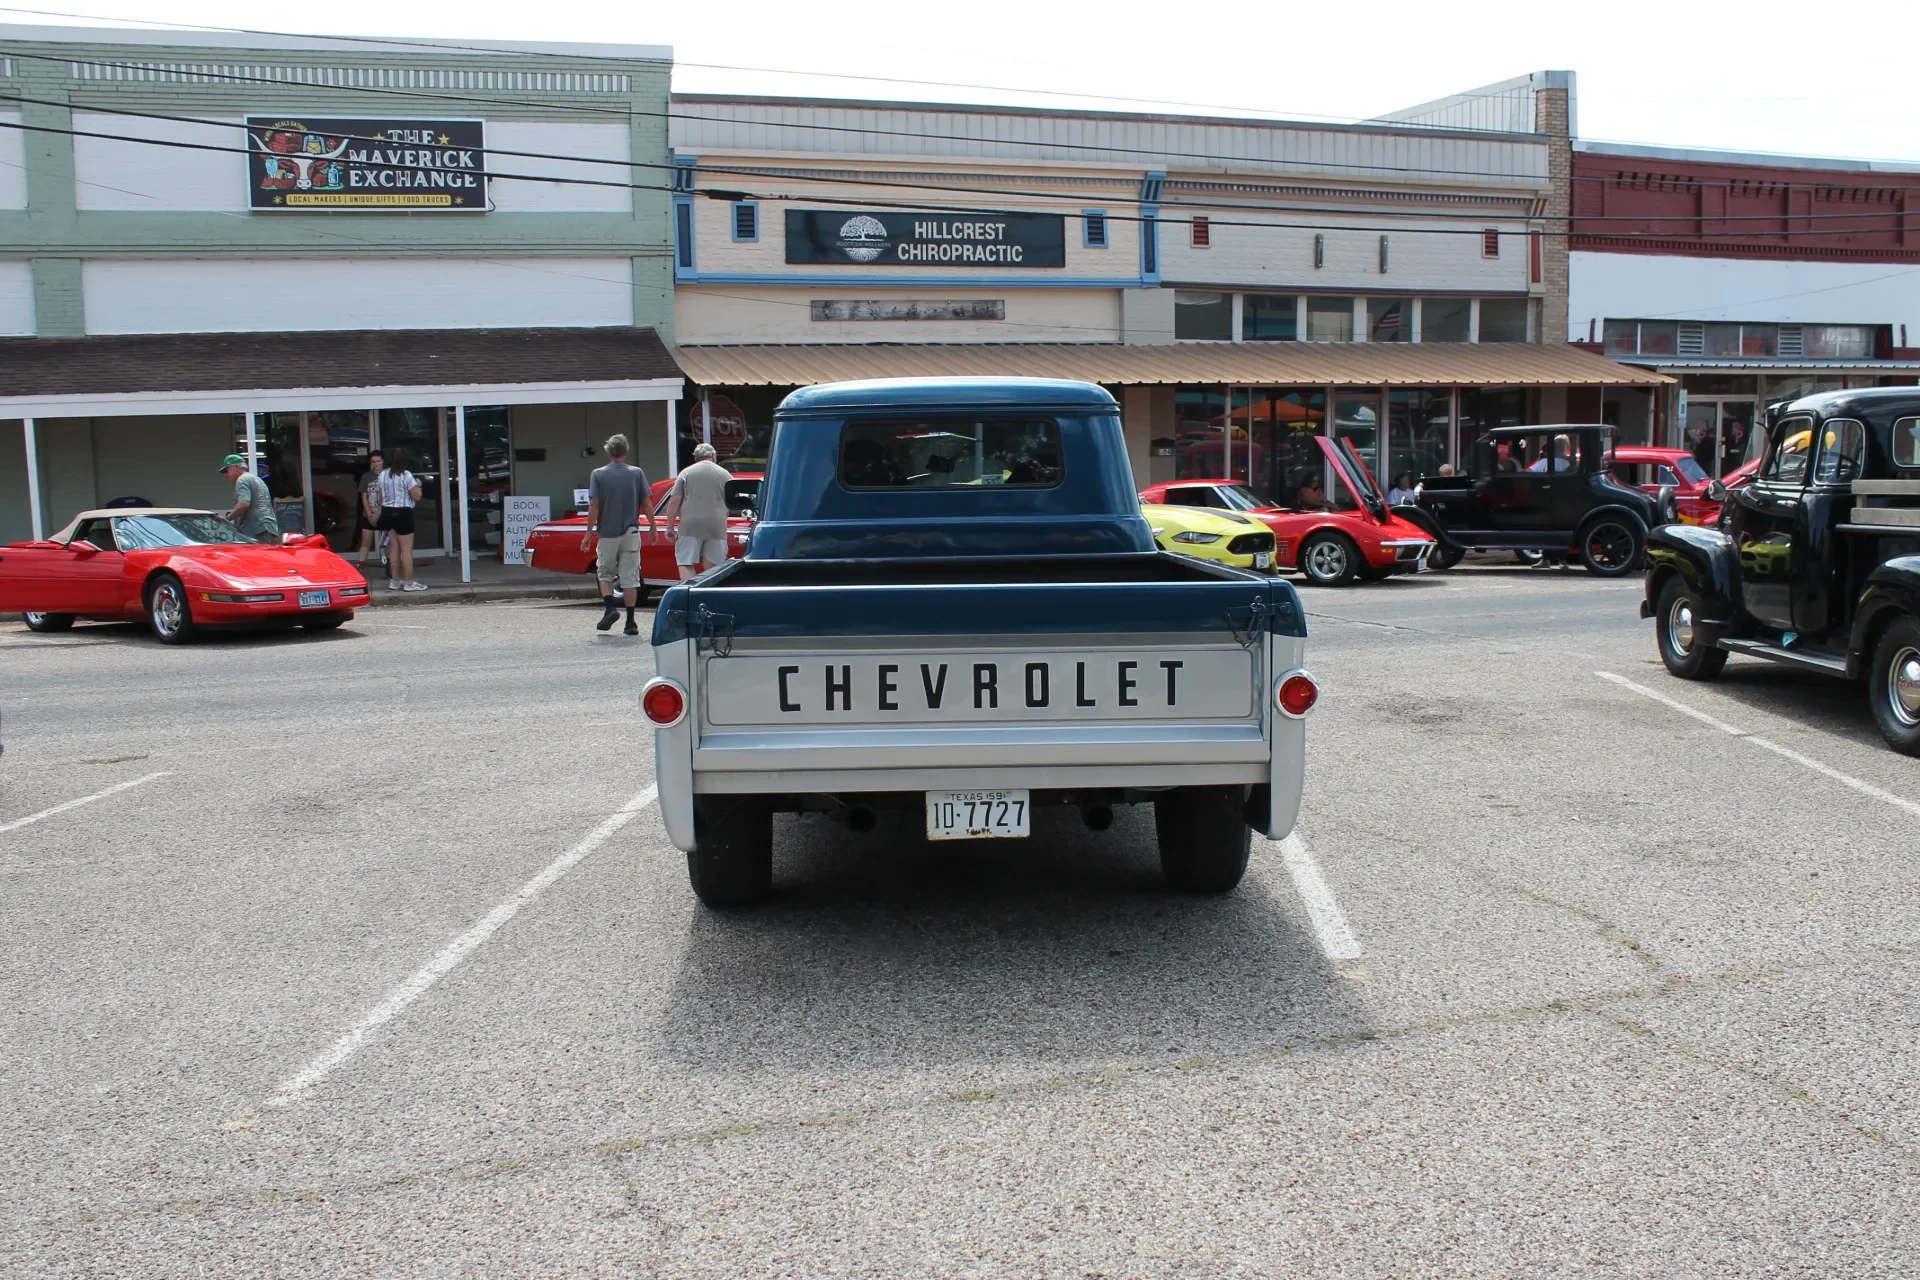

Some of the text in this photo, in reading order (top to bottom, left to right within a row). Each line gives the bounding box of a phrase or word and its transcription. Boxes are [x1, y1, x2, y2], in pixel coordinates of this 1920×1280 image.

[387, 129, 435, 146] THE
[348, 149, 475, 168] MAVERICK
[349, 169, 477, 188] EXCHANGE
[289, 195, 311, 203] LOCAL
[314, 195, 341, 203] MAKERS
[349, 195, 373, 203] UNIQUE
[376, 195, 396, 203] GIFTS
[423, 196, 449, 204] TRUCKS
[914, 221, 1006, 240] HILLCREST
[897, 243, 1023, 262] CHIROPRACTIC
[693, 415, 743, 436] STOP
[513, 501, 541, 510] BOOK
[507, 513, 547, 522] SIGNING
[777, 660, 1184, 712] CHEVROLET
[950, 792, 983, 801] TEXAS
